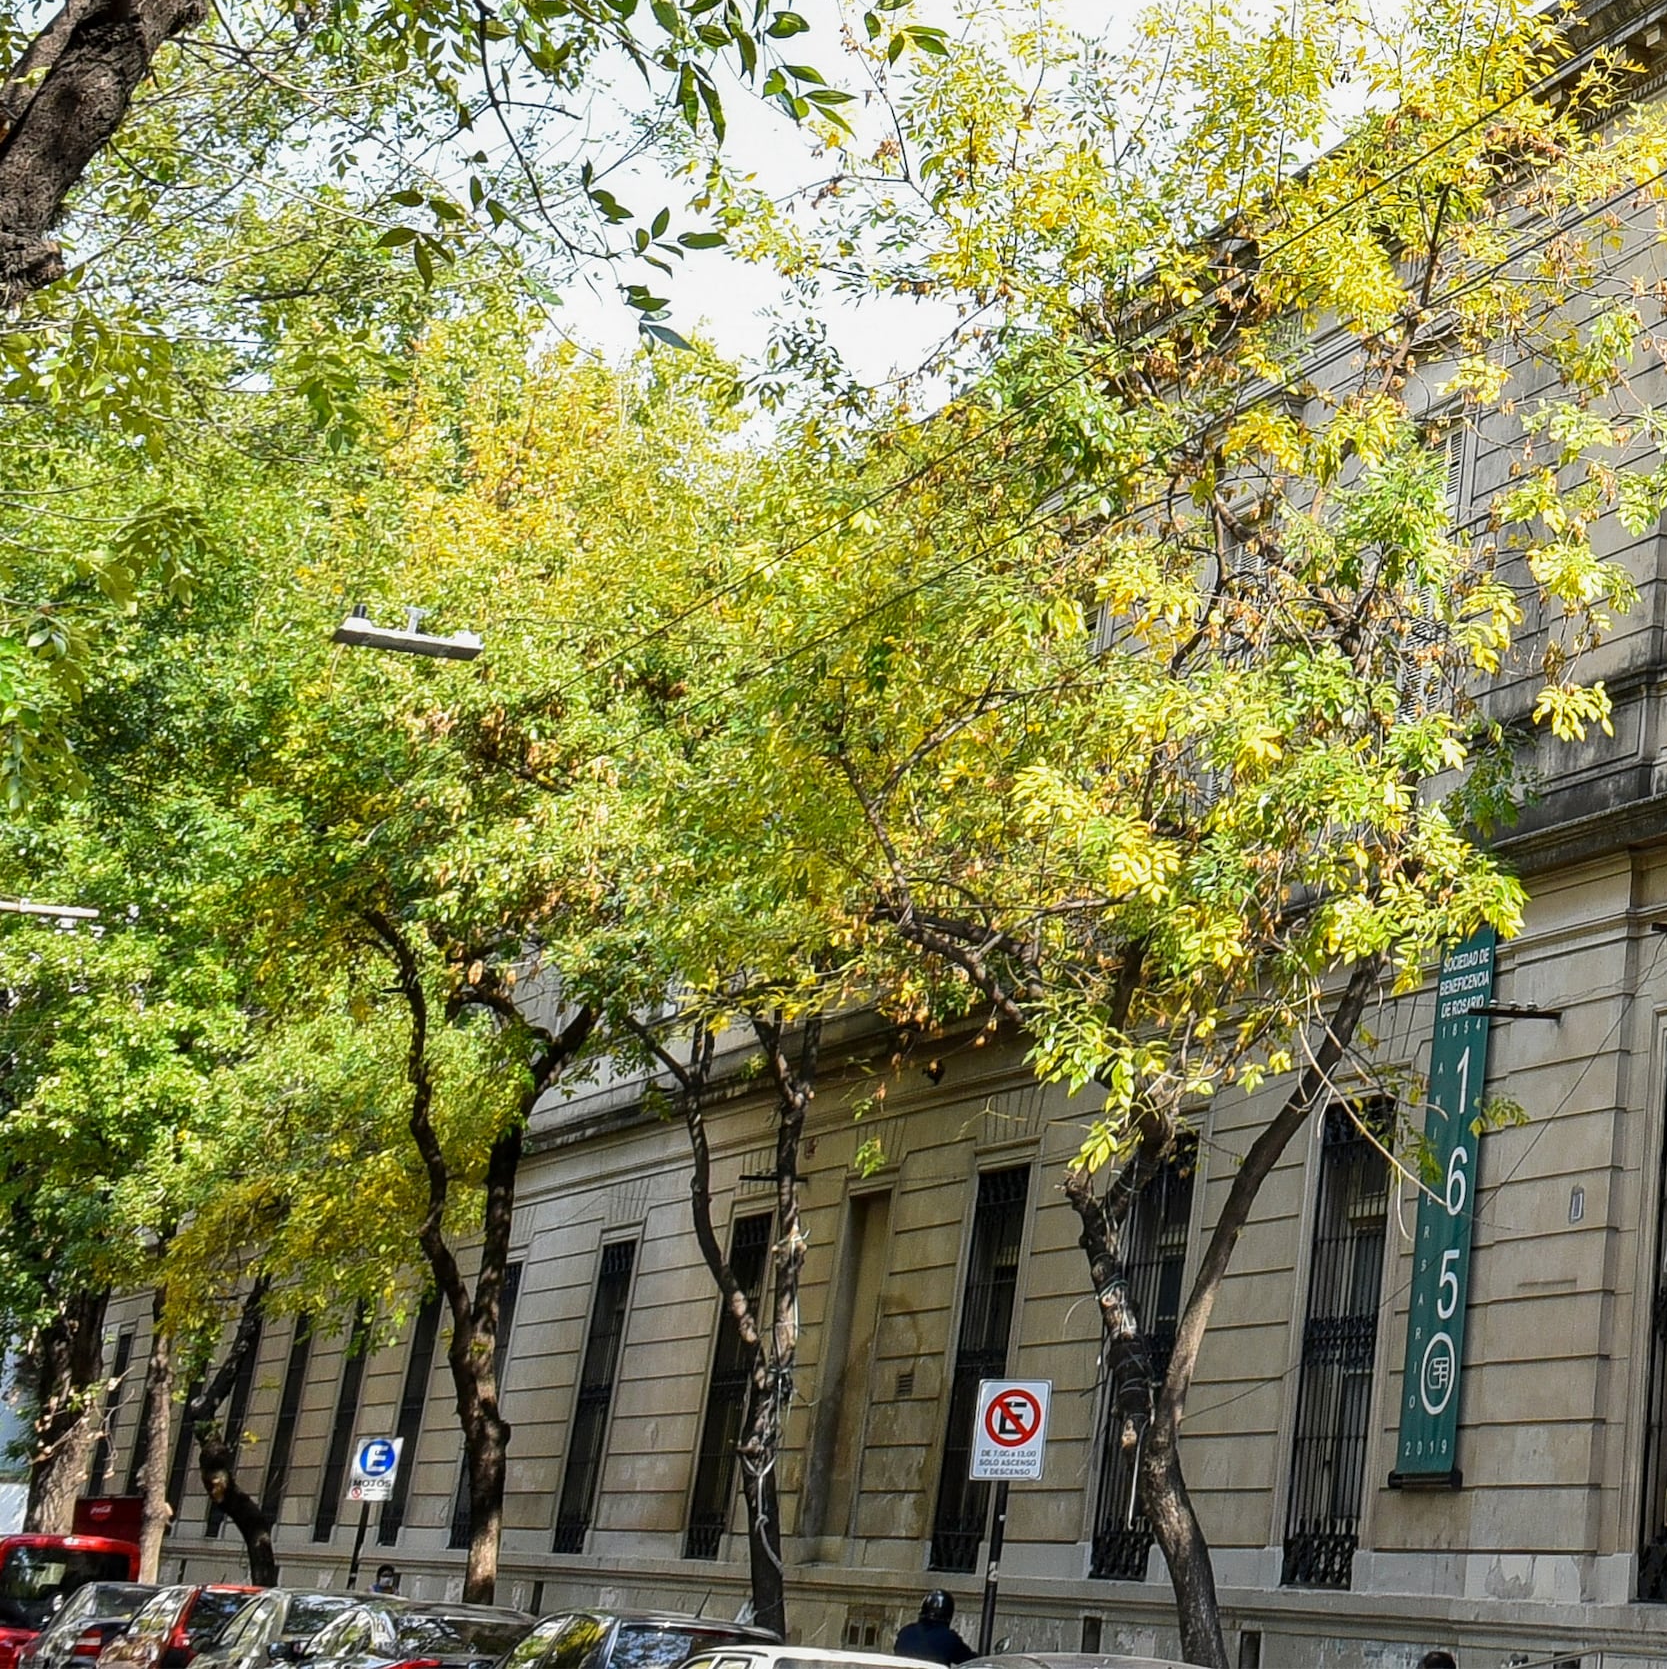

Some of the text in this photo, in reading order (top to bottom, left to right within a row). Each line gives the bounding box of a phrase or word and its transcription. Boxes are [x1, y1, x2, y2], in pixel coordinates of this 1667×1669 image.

[1480, 947, 1490, 965] DE
[1439, 970, 1490, 997] BENEFICENCIA
[1441, 1001, 1451, 1019] DE
[1405, 1438, 1447, 1457] 2019
[366, 1444, 390, 1472] E
[979, 1458, 1037, 1467] SOLO ASCENSO
[990, 1468, 1031, 1476] DESCENSO
[353, 1479, 392, 1488] MOTOS
